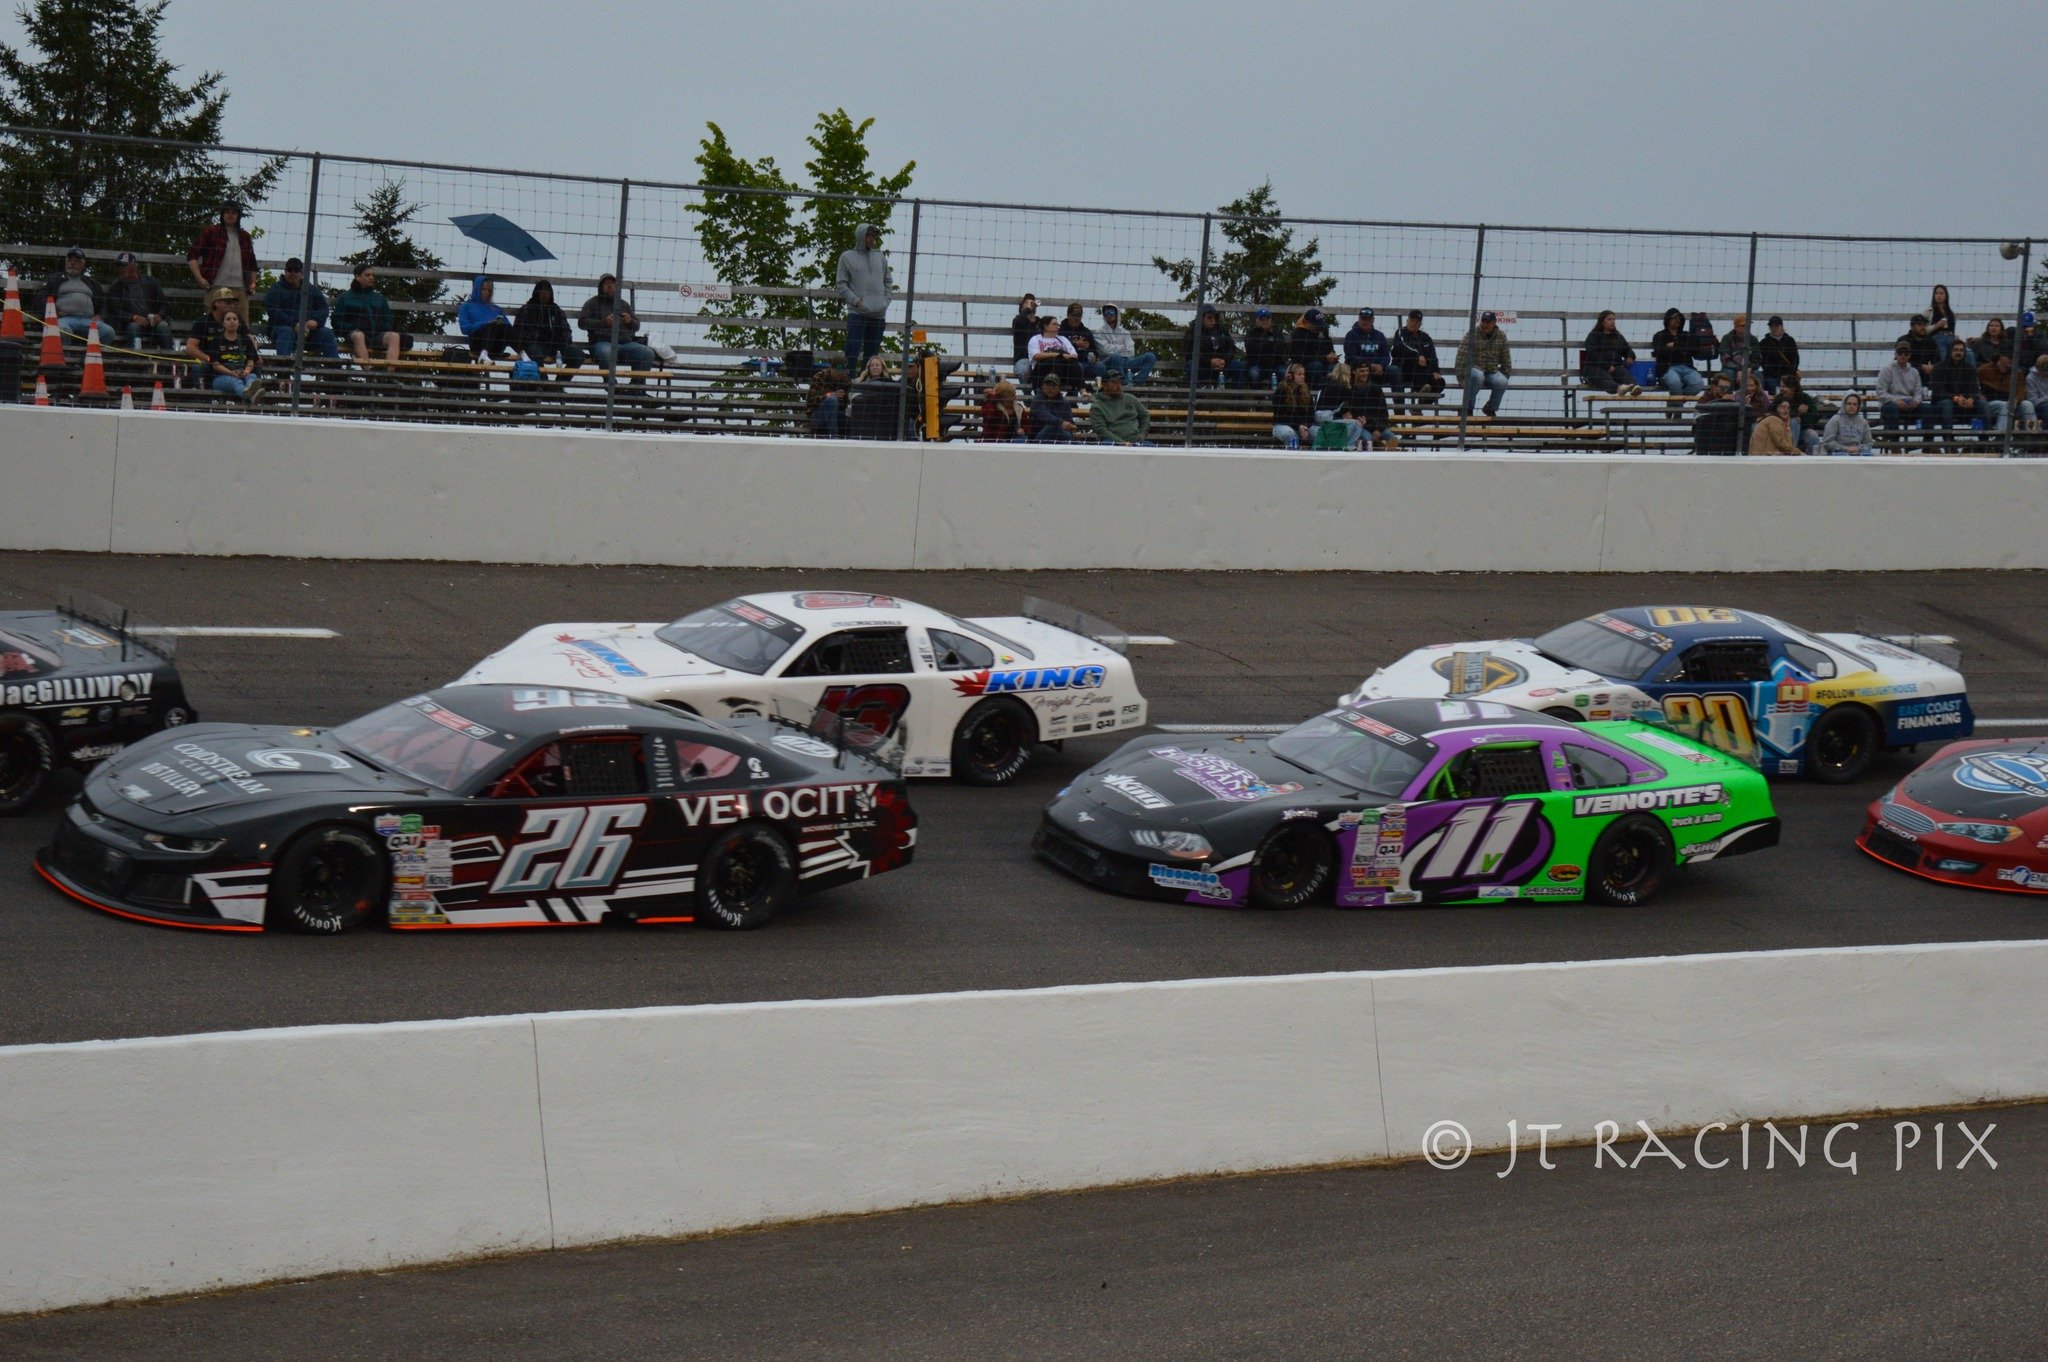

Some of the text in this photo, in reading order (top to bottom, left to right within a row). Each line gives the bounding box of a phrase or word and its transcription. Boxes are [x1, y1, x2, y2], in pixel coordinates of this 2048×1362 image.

[0, 673, 153, 705] acGILLIVRAY
[985, 665, 1105, 694] KING
[1816, 683, 1918, 700] #FOLLOWTHELIGHTHOUSE
[1032, 694, 1077, 712] Freight
[1898, 700, 1962, 716] EAST COAST
[1897, 712, 1962, 729] FINANCING
[173, 743, 273, 795] COLDSTREAM
[677, 783, 878, 827] VELOCITY
[1574, 784, 1723, 816] VEINOTTE'S
[1419, 801, 1534, 881] 11
[1877, 820, 1918, 842] FUSION
[489, 803, 648, 894] 26
